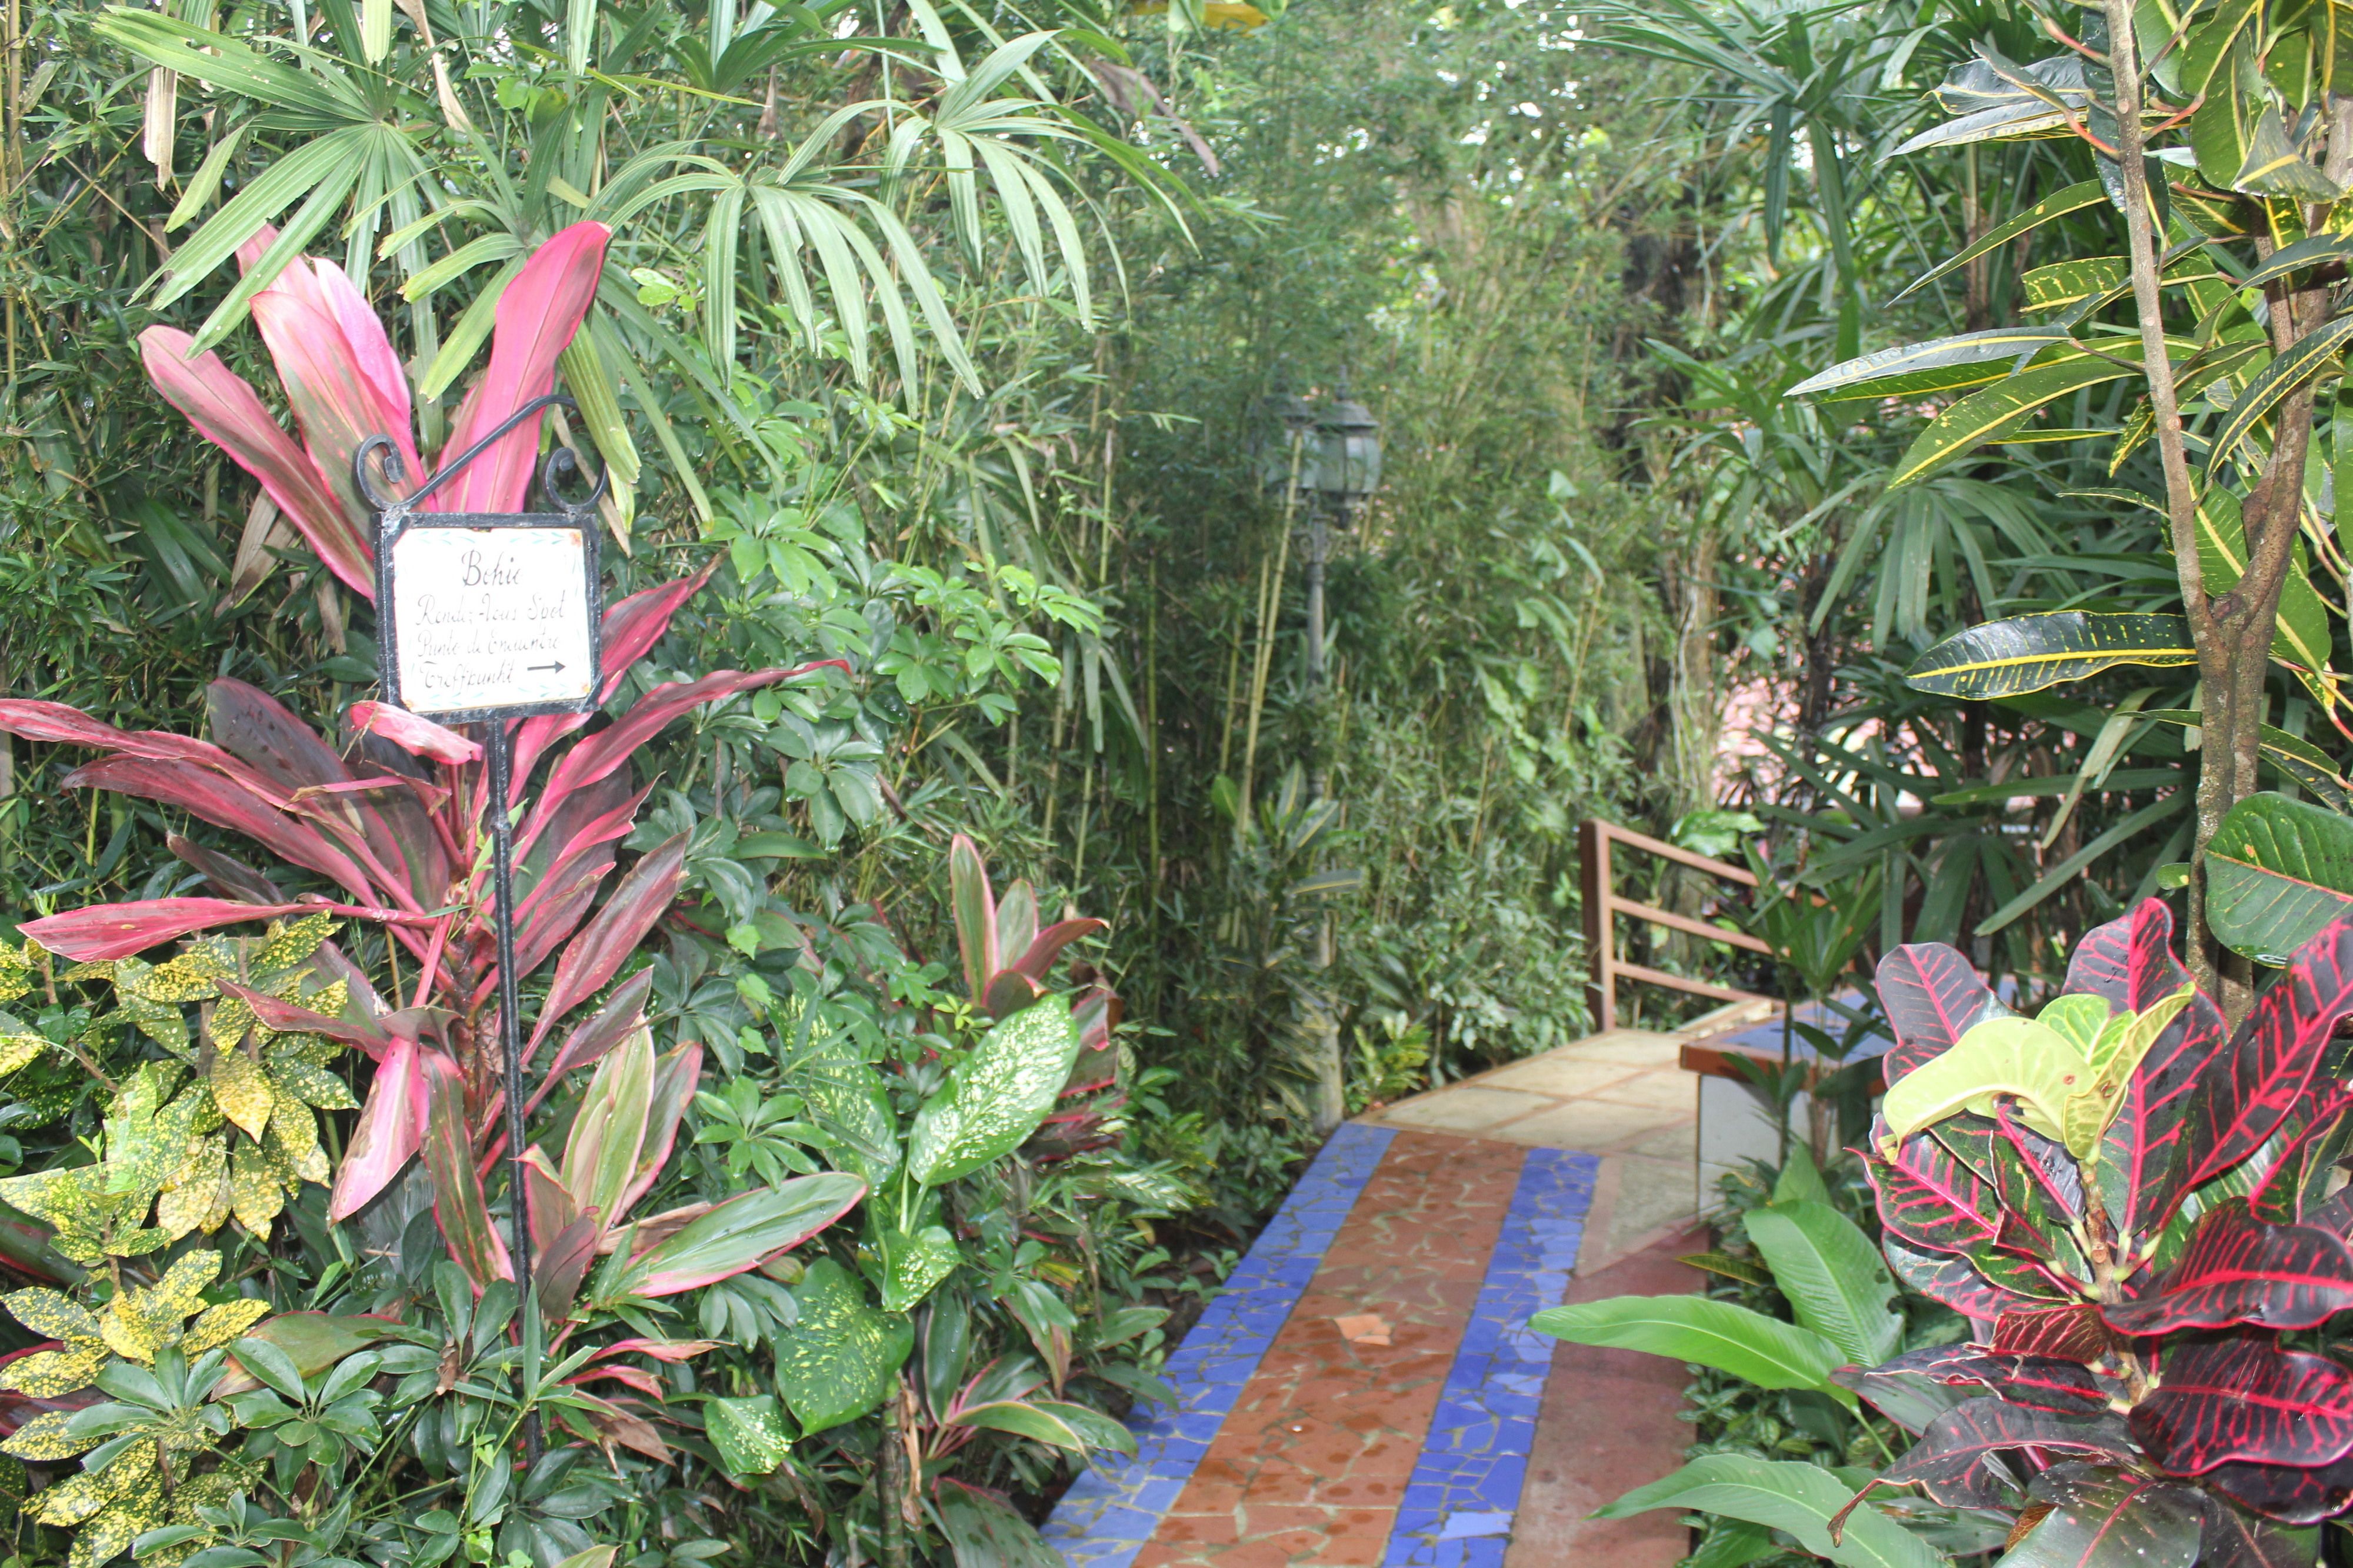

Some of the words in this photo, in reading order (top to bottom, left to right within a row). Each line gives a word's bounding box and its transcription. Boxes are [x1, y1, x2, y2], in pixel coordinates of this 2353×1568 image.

[527, 589, 565, 628] Spot
[417, 629, 460, 657] Punto
[466, 628, 481, 654] de
[419, 659, 515, 692] Treffpunkt
